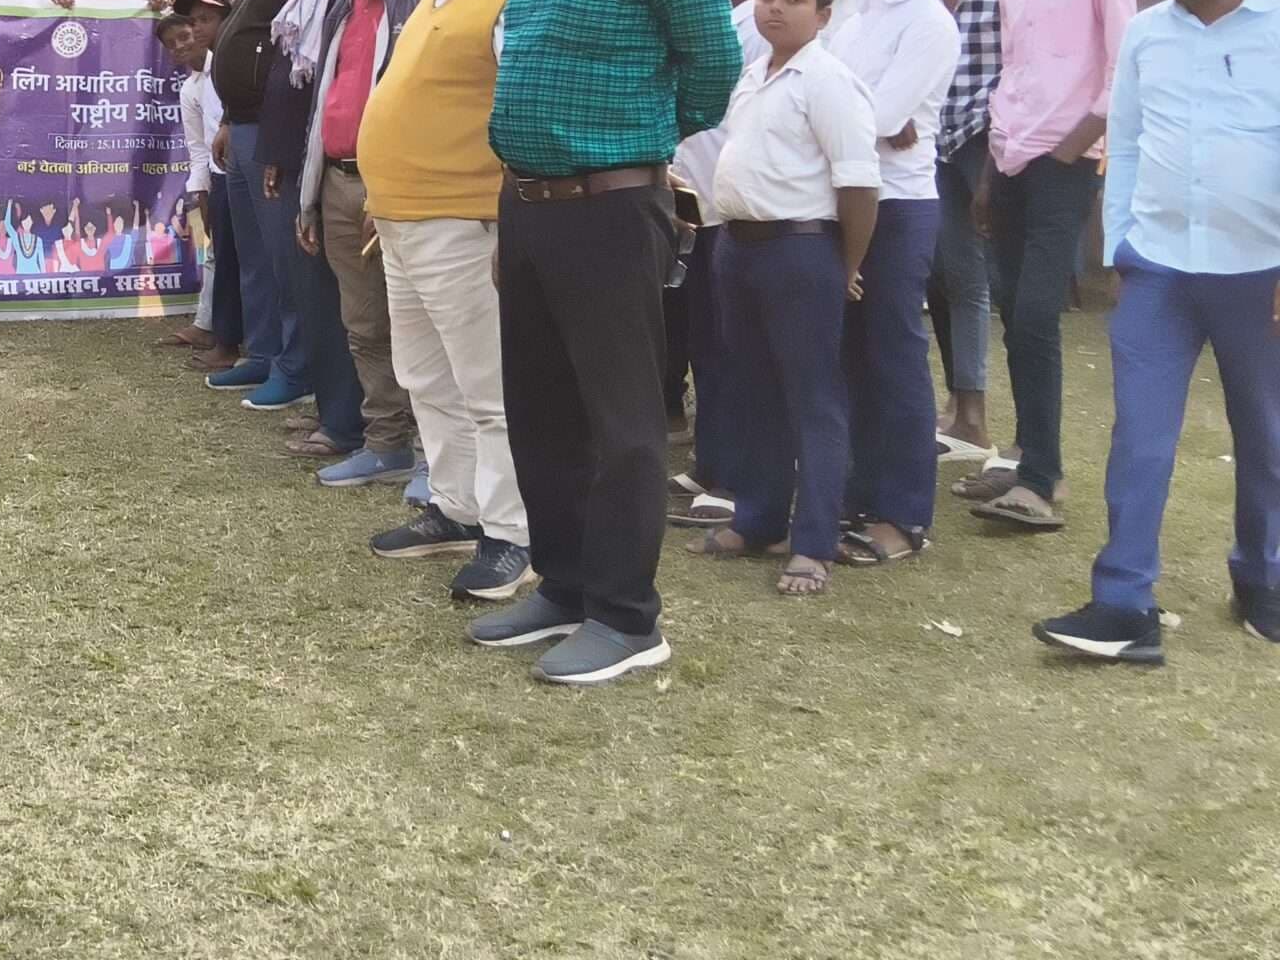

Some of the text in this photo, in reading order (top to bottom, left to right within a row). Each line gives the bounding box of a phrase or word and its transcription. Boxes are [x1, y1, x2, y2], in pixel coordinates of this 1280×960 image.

[10, 65, 50, 91] लिंग
[56, 70, 130, 93] आधारित
[70, 98, 129, 129] राष्ट्रीय
[55, 136, 88, 150] दिनांक
[16, 160, 36, 174] नई
[39, 160, 72, 174] चेतना
[75, 160, 129, 175] अभियान
[22, 275, 107, 296] प्रशासन,
[113, 272, 182, 292] सहरसा
